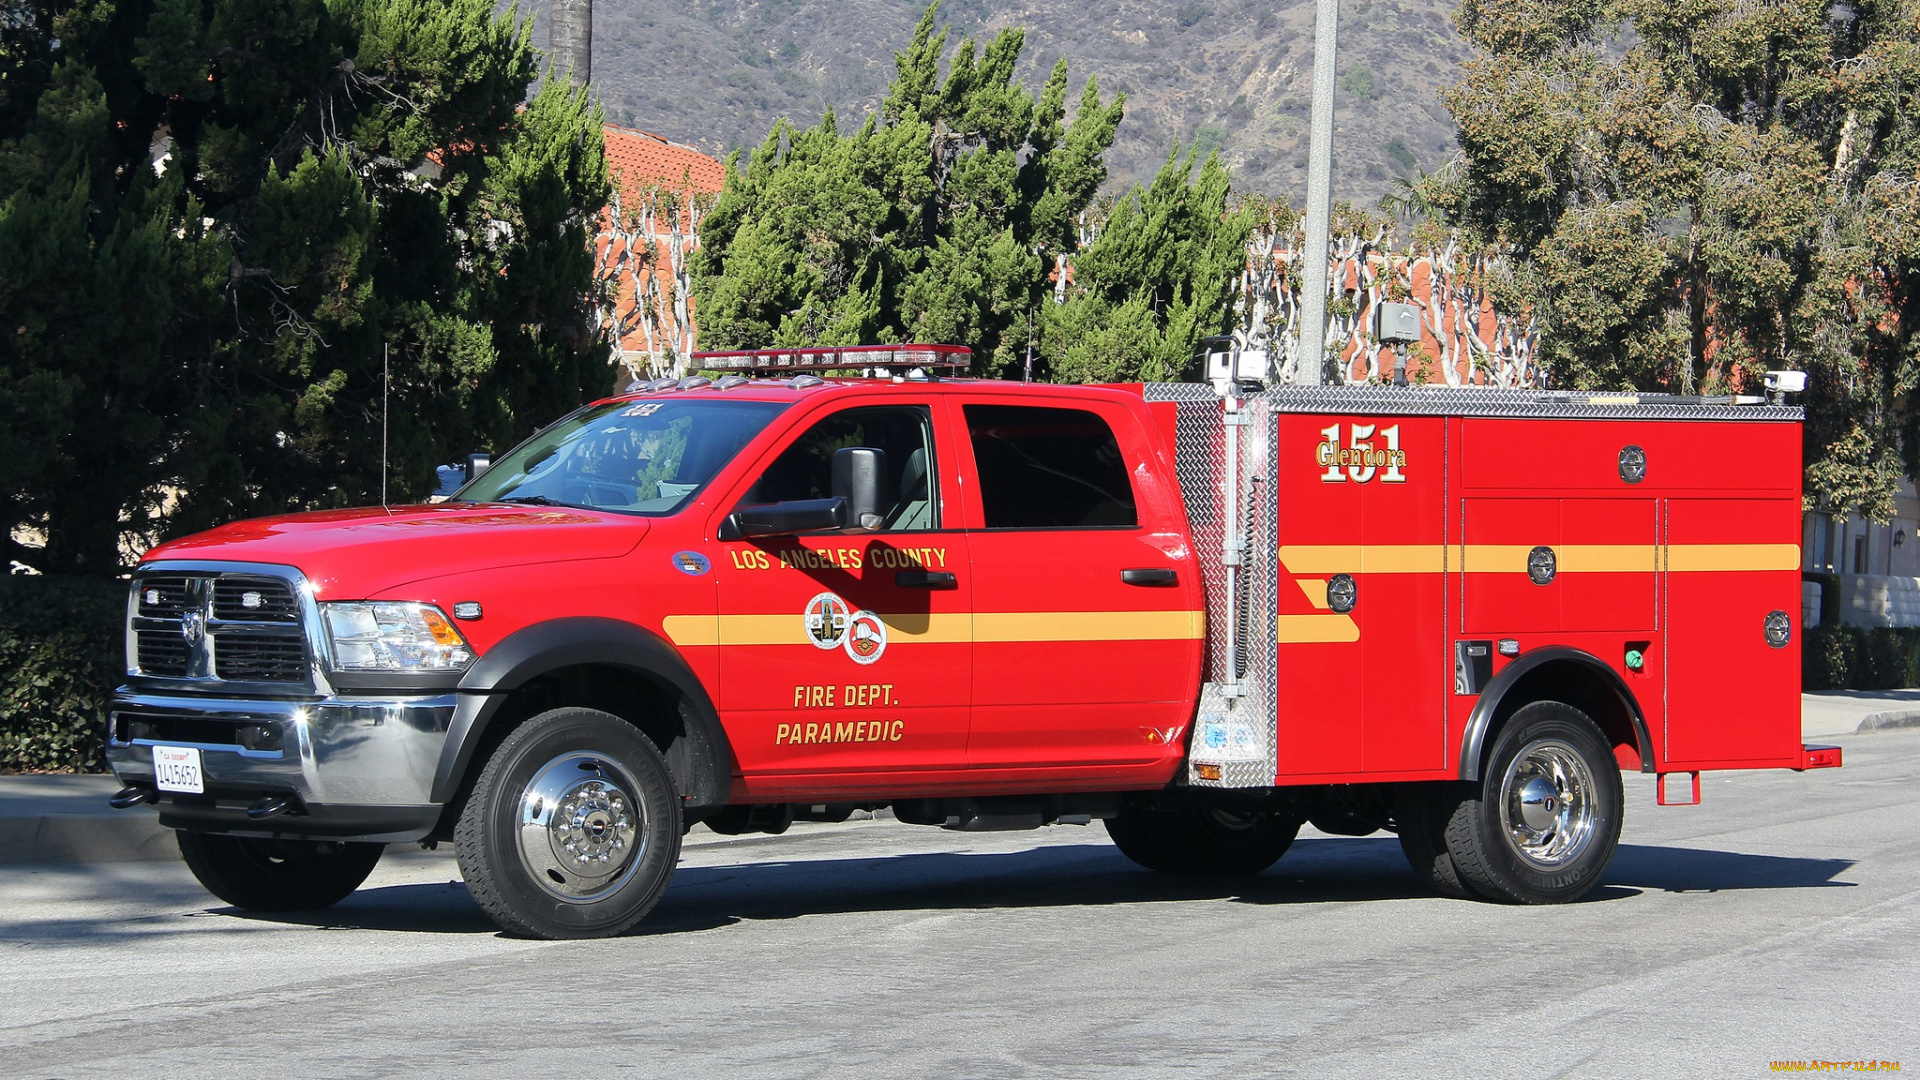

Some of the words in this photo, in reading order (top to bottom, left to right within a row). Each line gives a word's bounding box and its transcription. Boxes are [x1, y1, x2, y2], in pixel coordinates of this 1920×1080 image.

[620, 403, 665, 417] 151
[1315, 440, 1407, 467] Glendora
[1320, 422, 1407, 484] 151
[731, 550, 770, 570] LOS
[780, 548, 862, 570] ANGELES
[870, 547, 946, 569] COUNTY
[807, 597, 818, 611] COUNTY
[833, 596, 847, 612] ANGELES
[816, 641, 840, 649] CALIFORNIA
[851, 649, 882, 661] DEPARTMENT
[794, 685, 836, 708] FIRE
[843, 684, 899, 707] DEPT.
[775, 720, 904, 745] PARAMEDIC
[158, 764, 199, 786] 1415652
